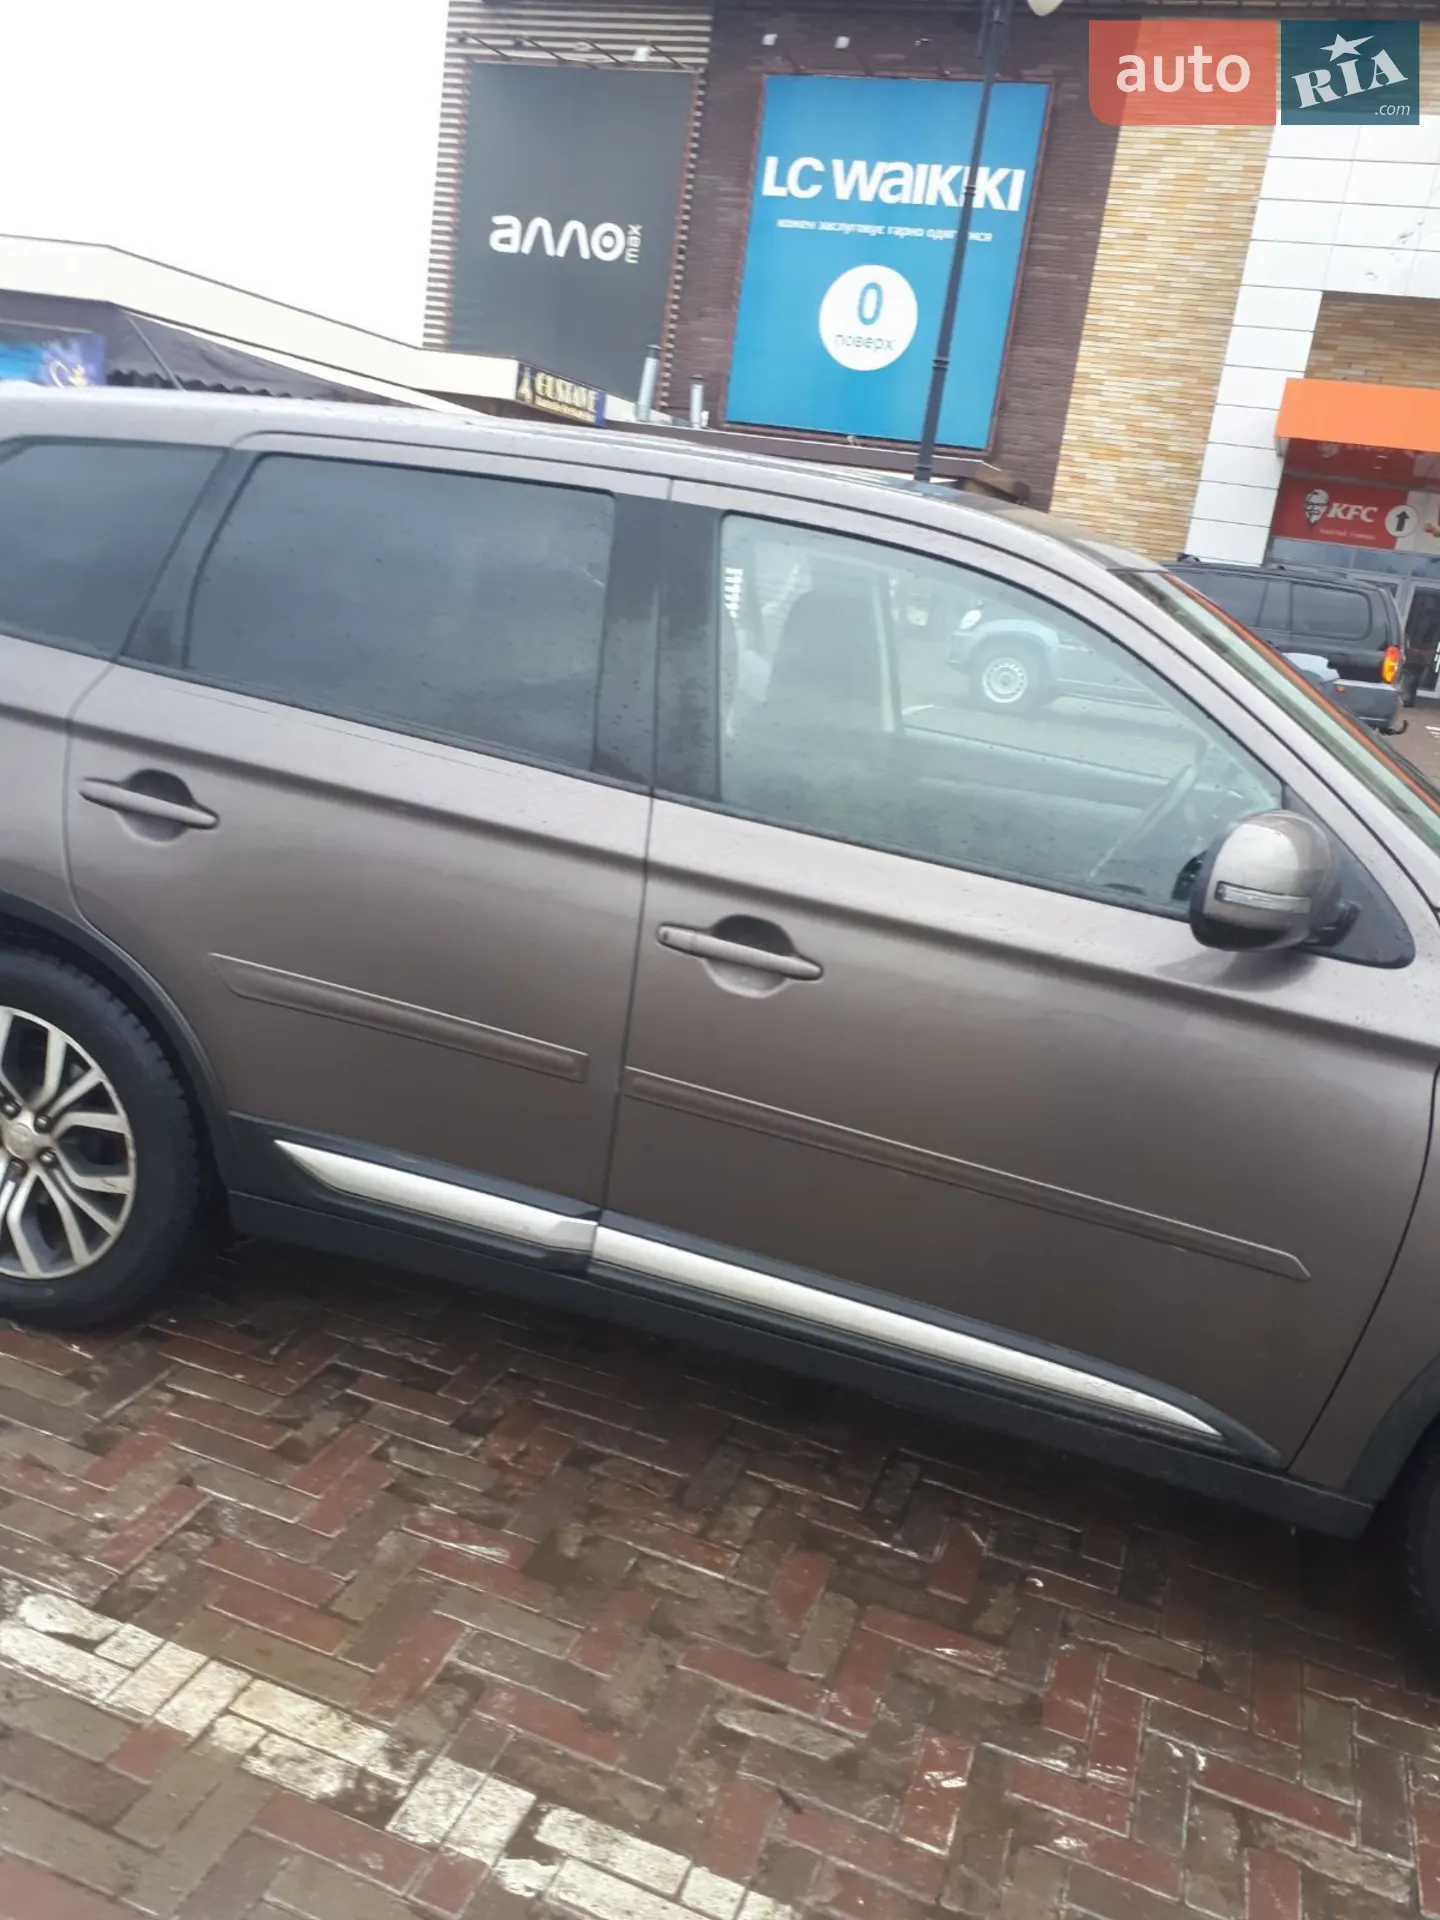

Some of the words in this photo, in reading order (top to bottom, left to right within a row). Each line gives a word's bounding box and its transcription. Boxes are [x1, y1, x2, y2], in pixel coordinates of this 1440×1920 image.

[762, 156, 825, 199] LC
[624, 223, 643, 264] max
[857, 281, 883, 326] 0
[834, 333, 895, 353] поверх
[1326, 501, 1379, 523] KFC
